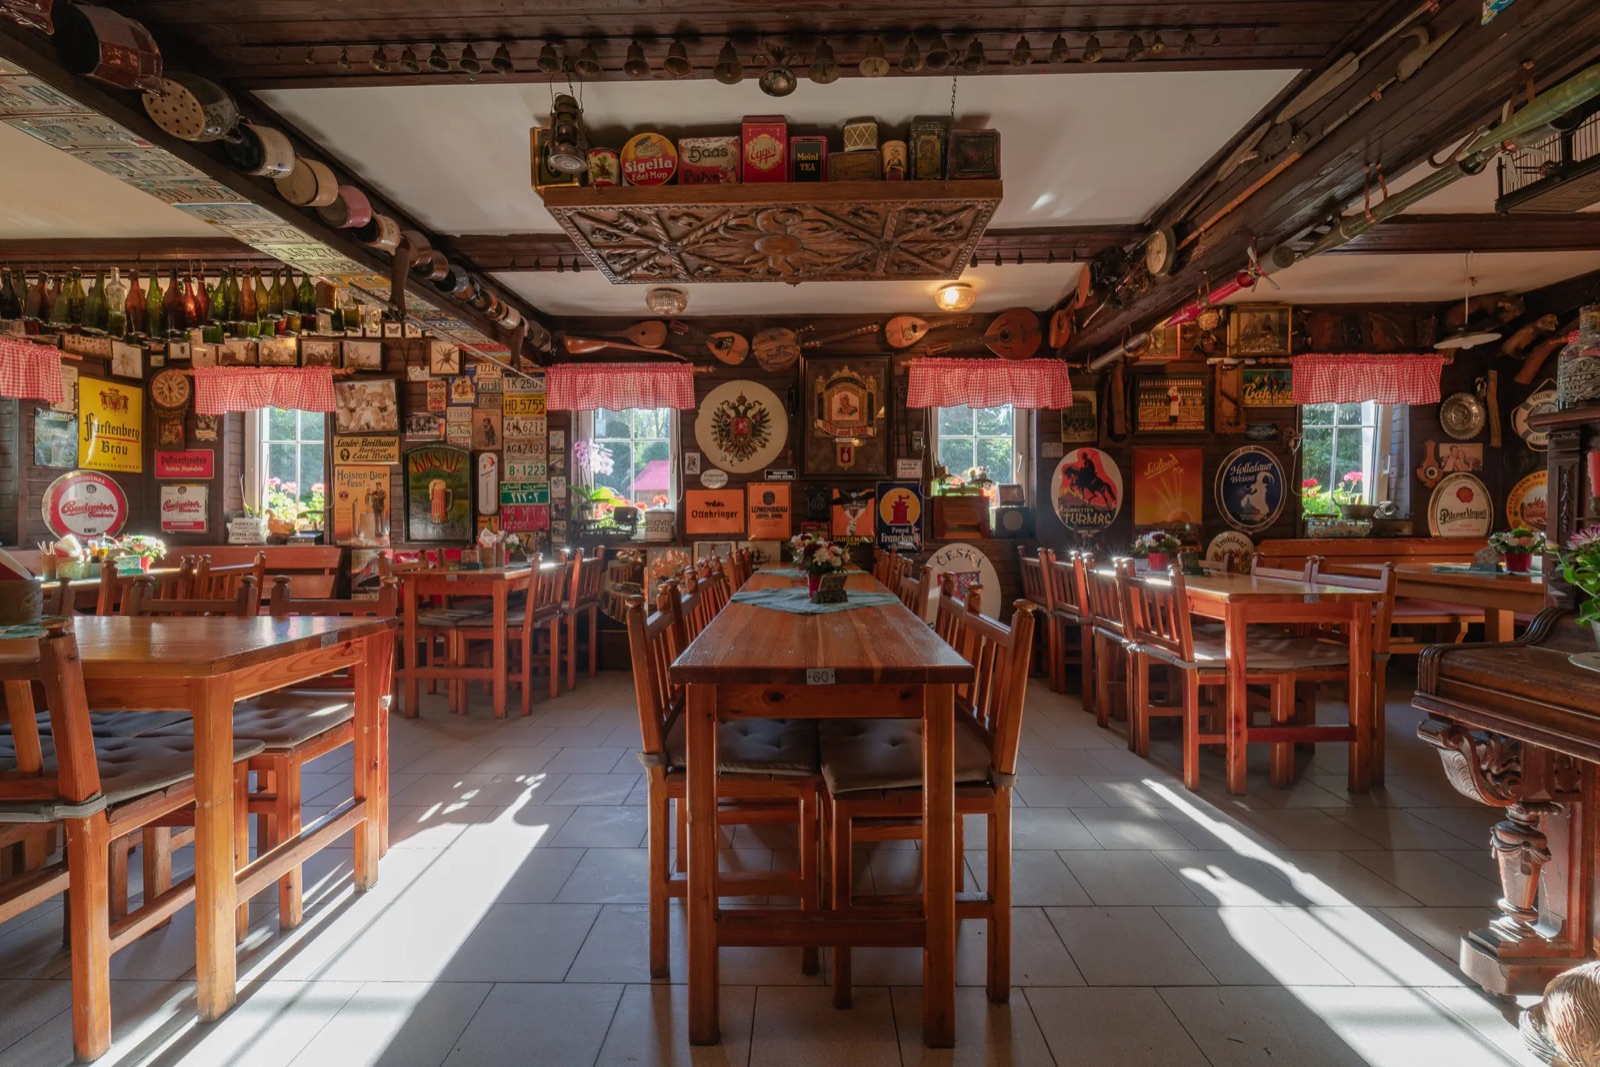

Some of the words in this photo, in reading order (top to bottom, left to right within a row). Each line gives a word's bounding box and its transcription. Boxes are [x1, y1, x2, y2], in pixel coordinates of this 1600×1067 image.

[624, 158, 673, 173] Sigella
[799, 163, 815, 171] TEA
[504, 400, 517, 412] HD
[520, 399, 545, 412] 5755
[101, 440, 129, 456] Bräu
[73, 474, 106, 484] ORIGINAL
[1062, 513, 1112, 525] TURMAC
[813, 671, 829, 683] 60
